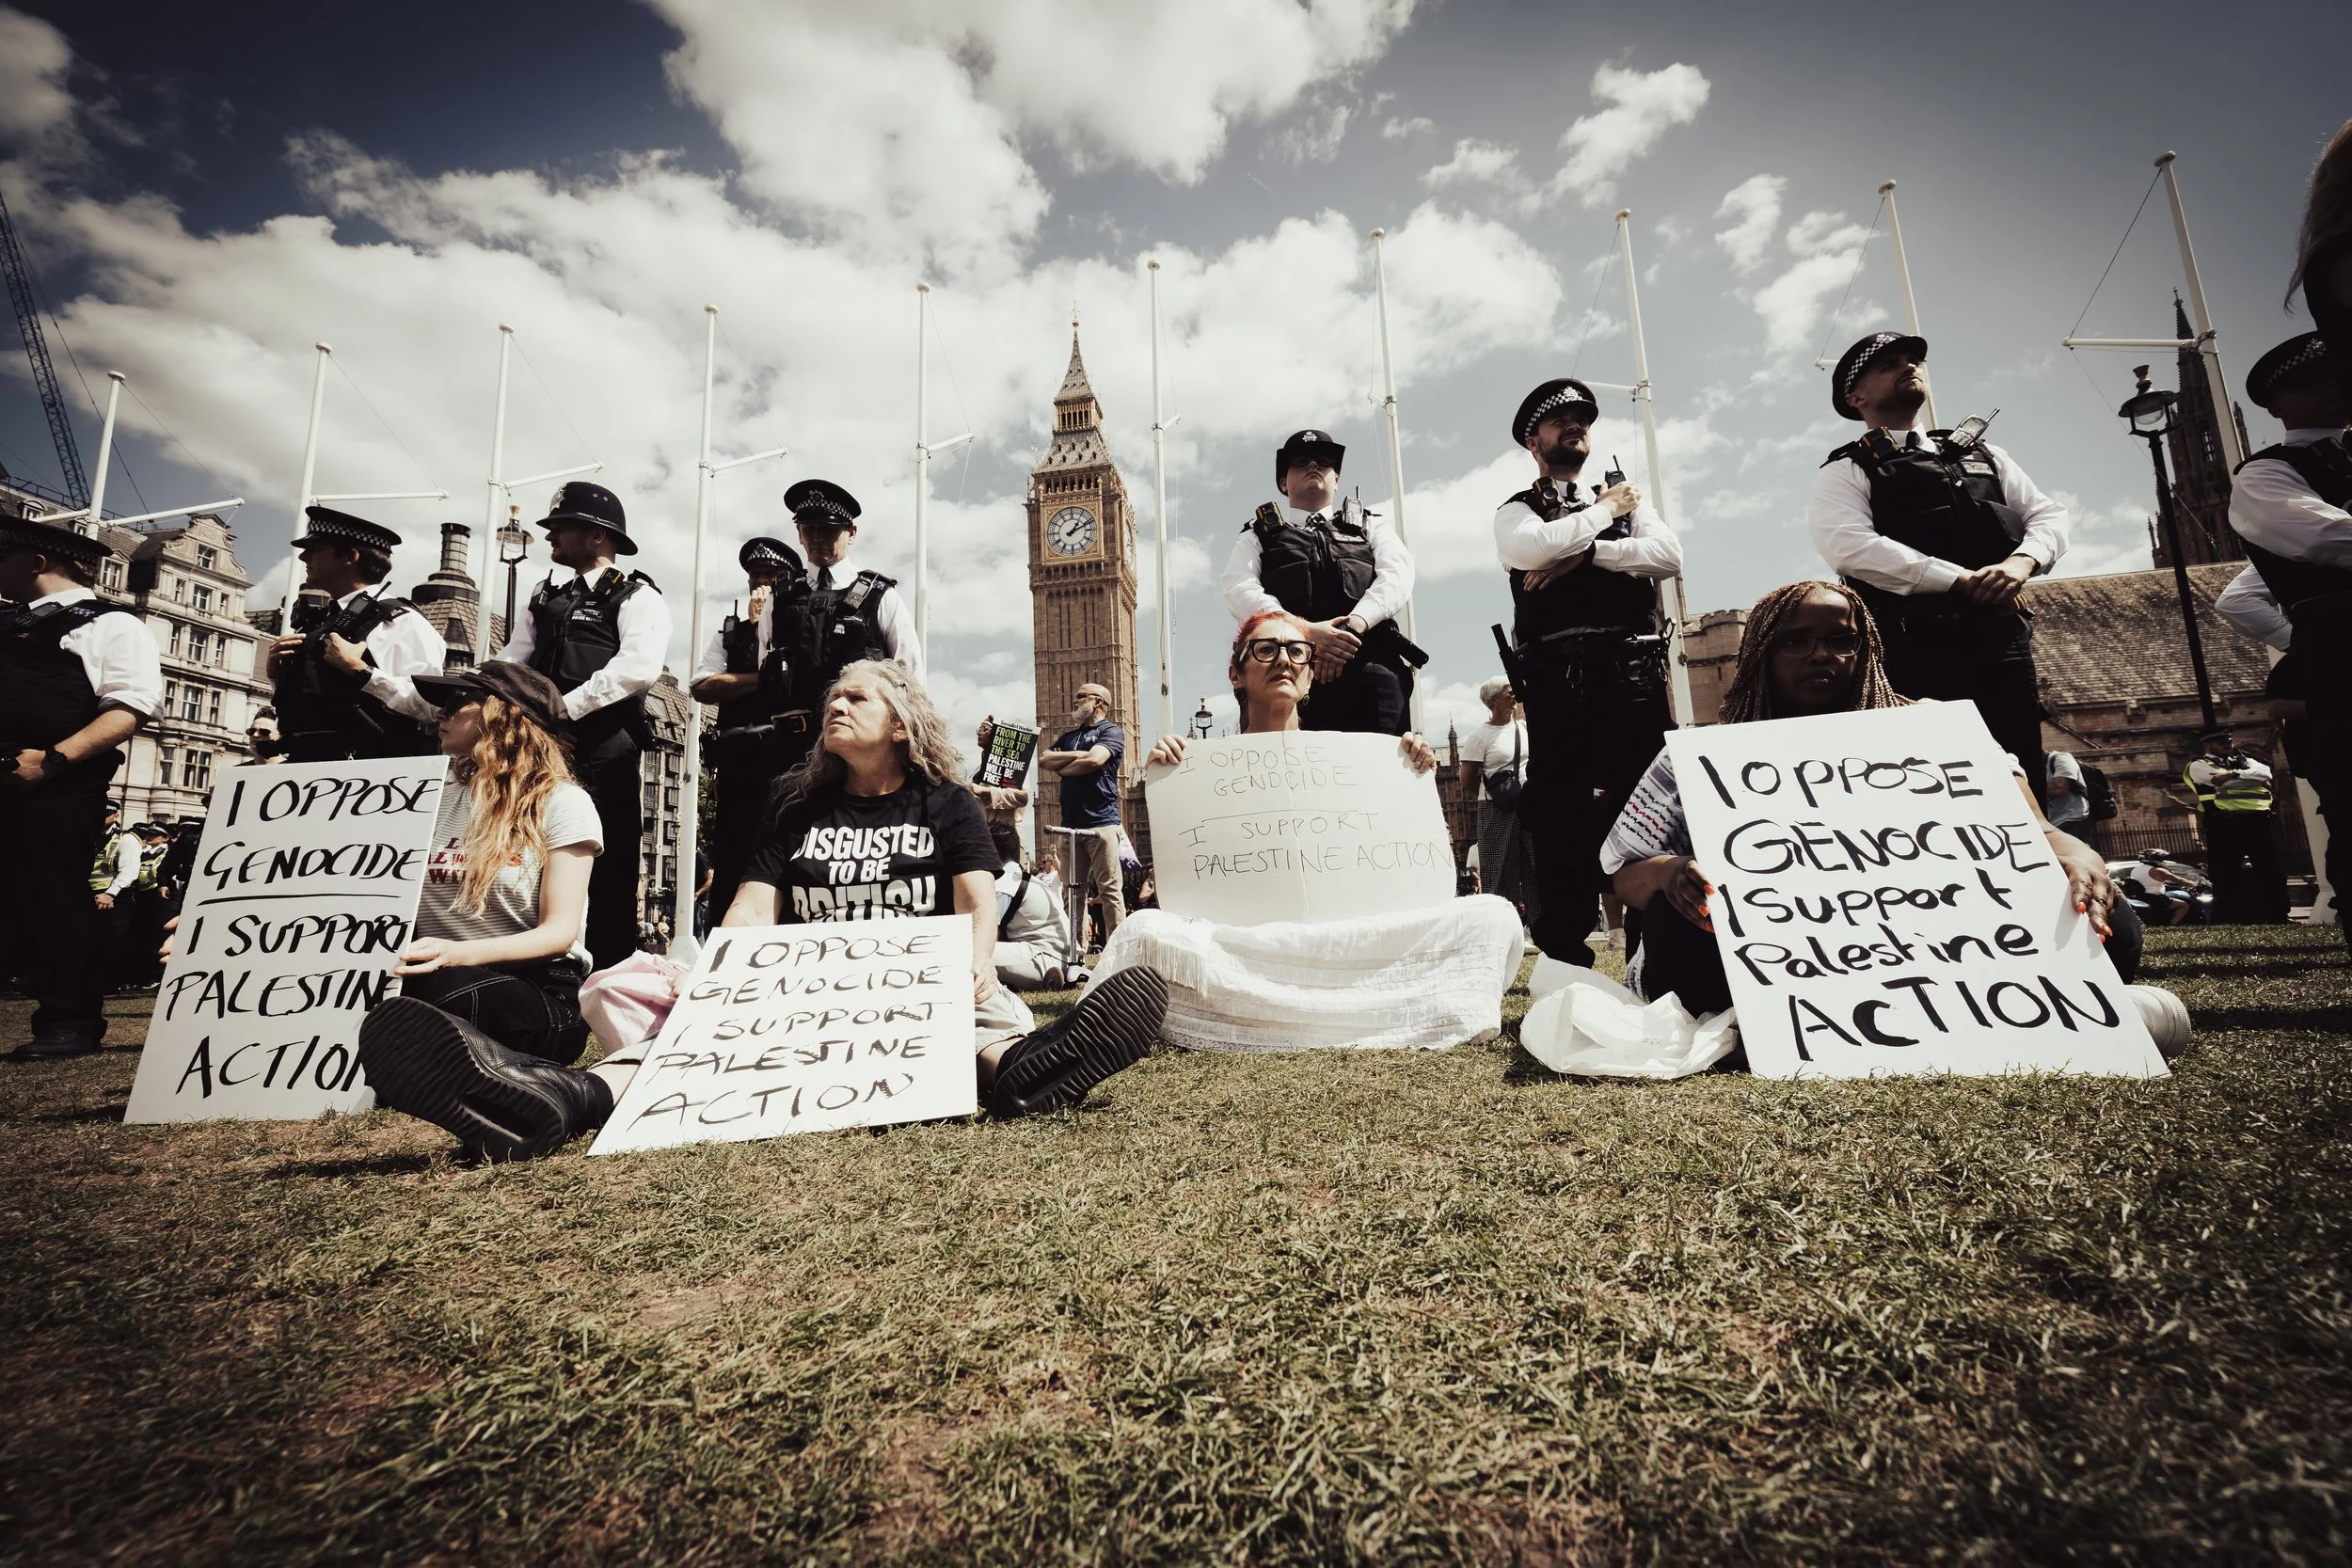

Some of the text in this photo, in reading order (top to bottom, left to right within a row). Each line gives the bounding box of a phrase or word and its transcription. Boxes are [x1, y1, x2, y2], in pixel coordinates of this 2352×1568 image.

[993, 736, 1025, 752] RIVER TO
[995, 726, 1032, 743] FROM THE
[1001, 721, 1019, 730] Socialist
[986, 763, 1014, 779] WILL BE
[988, 753, 1025, 770] PALESTINE
[991, 744, 1020, 760] THE SEA
[1209, 745, 1327, 771] OPPOSE
[983, 772, 1001, 785] FREE
[1213, 766, 1359, 797] GENOCIDE
[1696, 755, 1983, 809] I OPPOSE
[227, 776, 444, 828] I OPPOSE
[1178, 813, 1379, 847] I SUPPORT
[1723, 819, 2051, 875] GENOCIDE
[203, 842, 429, 891] GENOCIDE
[828, 857, 891, 885] TO BE
[1193, 842, 1452, 880] PALESTINE ACTION
[1718, 882, 1745, 937] I
[187, 913, 412, 957] I SUPPORT
[708, 934, 942, 974] I OPPOSE
[1734, 922, 2040, 986] Palestine
[166, 970, 400, 1022] PALESTINE
[689, 965, 948, 1006] GENOCIDE
[674, 1001, 953, 1047] I SUPPORT
[1788, 974, 2122, 1062] ACTION
[645, 1036, 934, 1086] PALESTINE
[626, 1072, 914, 1132] ACTION
